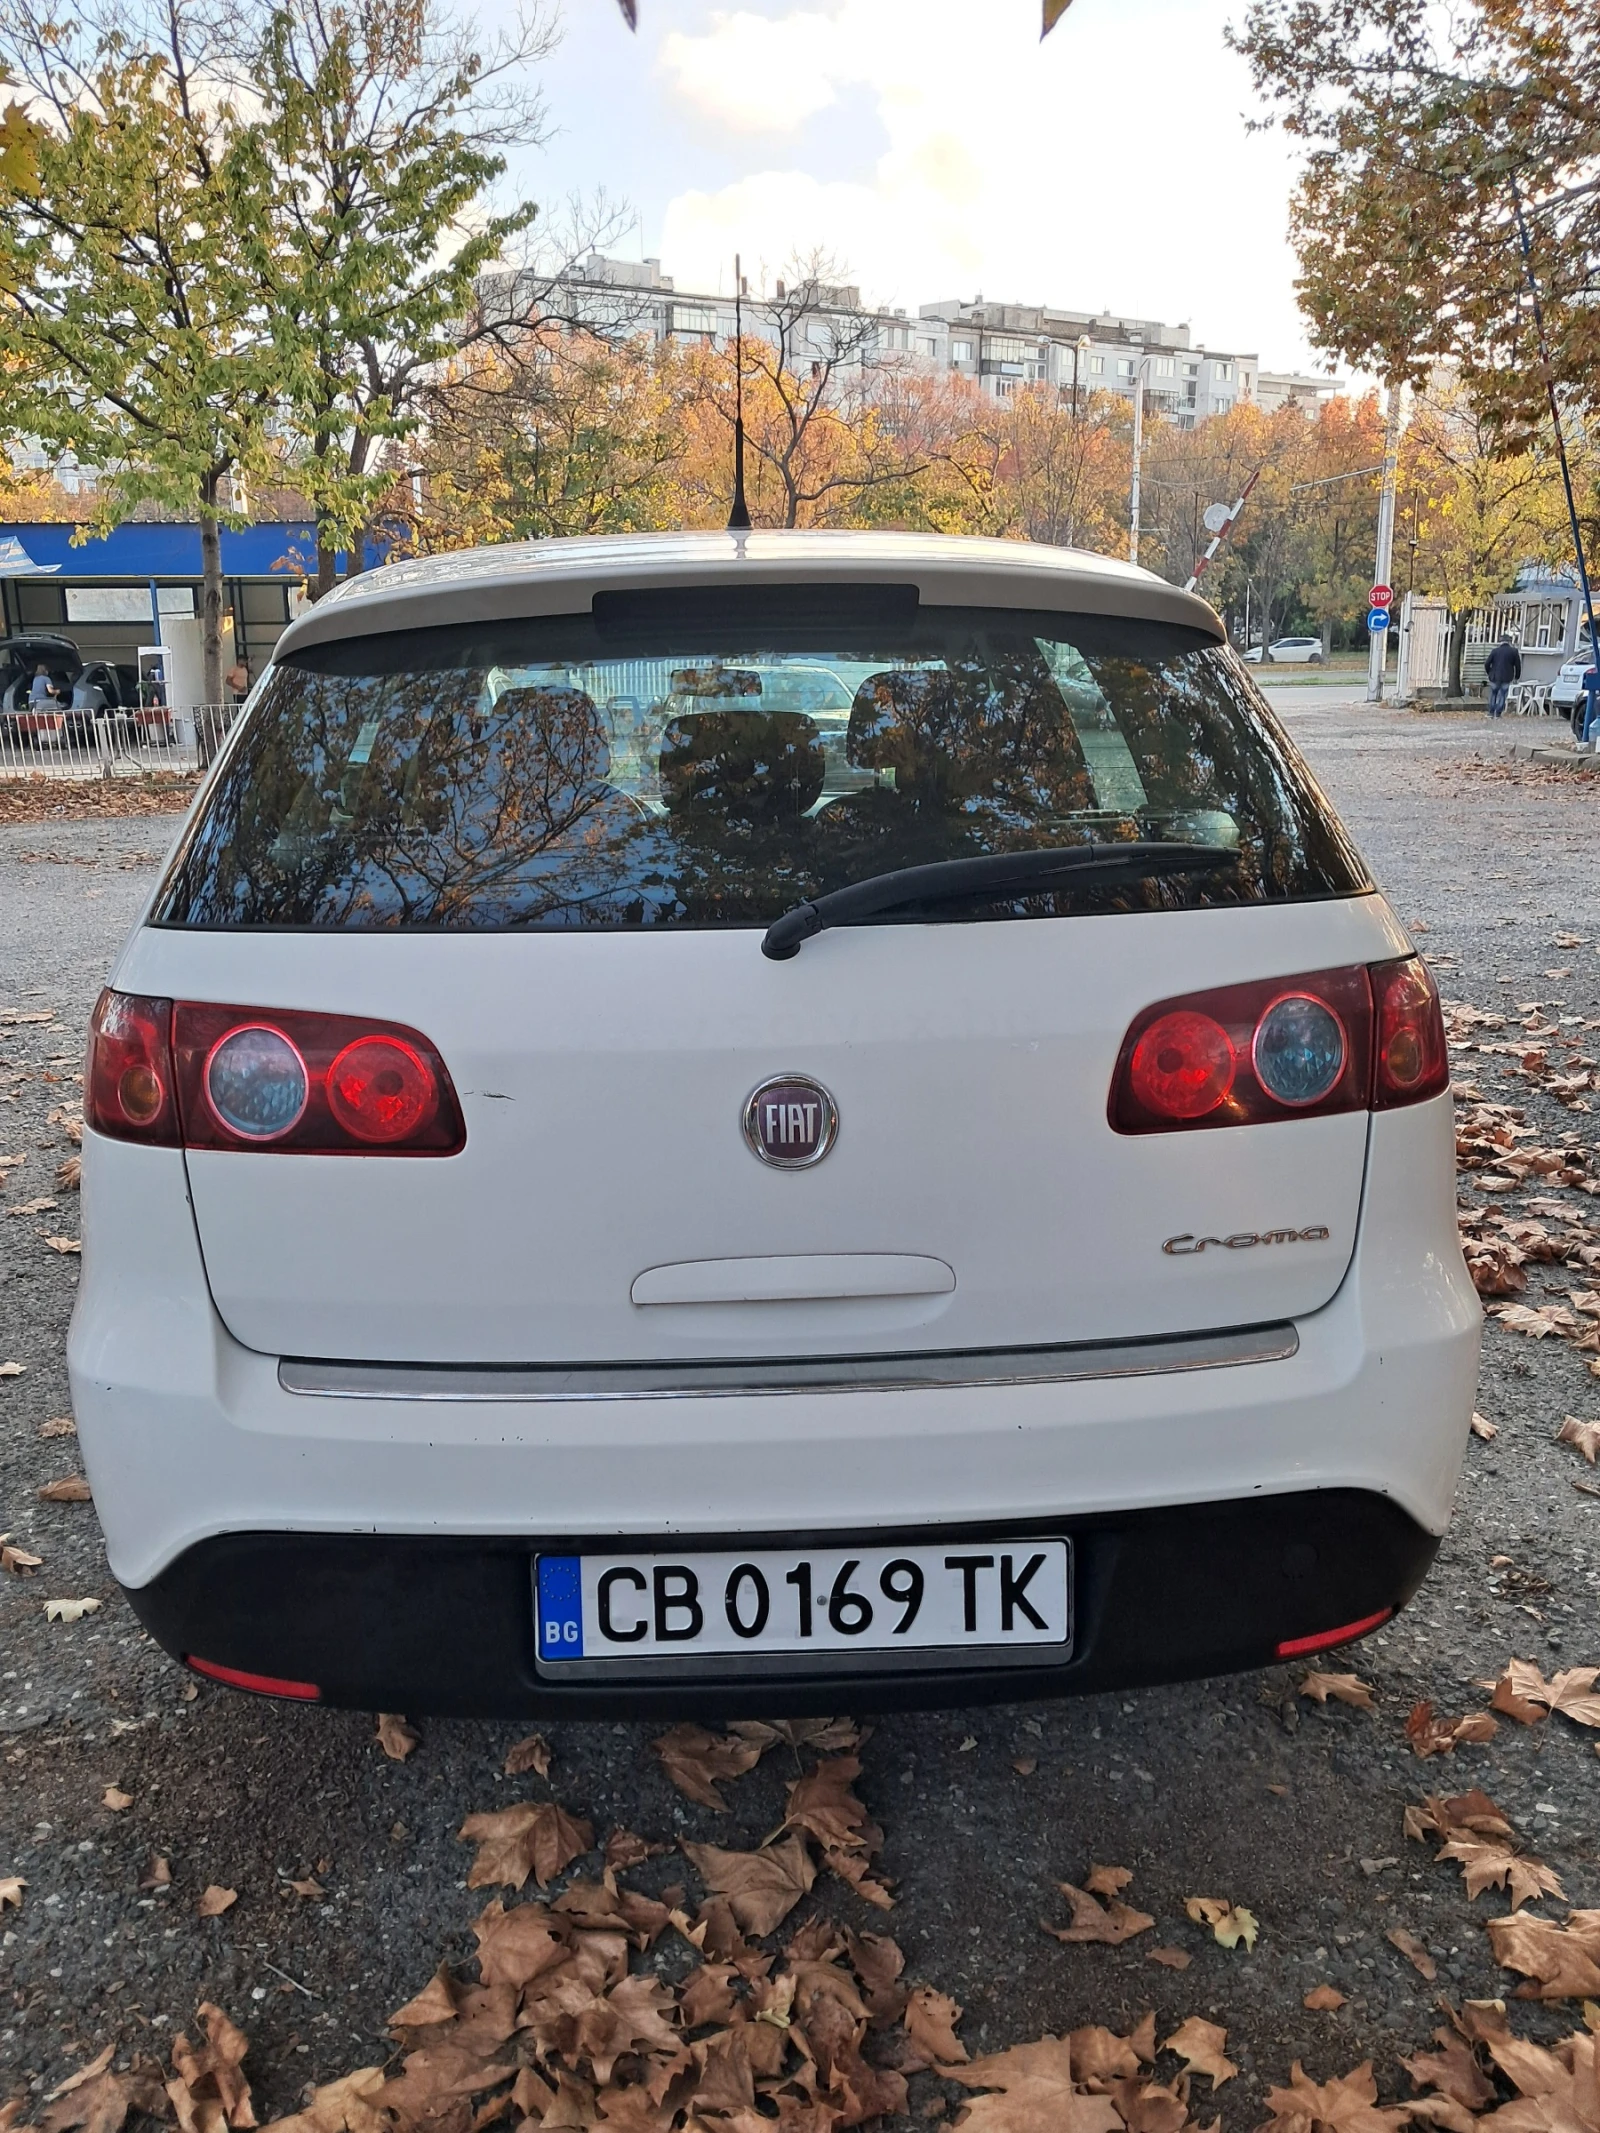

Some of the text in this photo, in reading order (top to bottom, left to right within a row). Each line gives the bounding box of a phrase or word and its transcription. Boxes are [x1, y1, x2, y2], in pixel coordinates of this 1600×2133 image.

[1370, 591, 1391, 601] STOP
[766, 1103, 818, 1144] FIAT
[1162, 1225, 1330, 1256] Croma
[597, 1553, 1049, 1643] CB 0169 TK
[545, 1621, 579, 1644] BG
